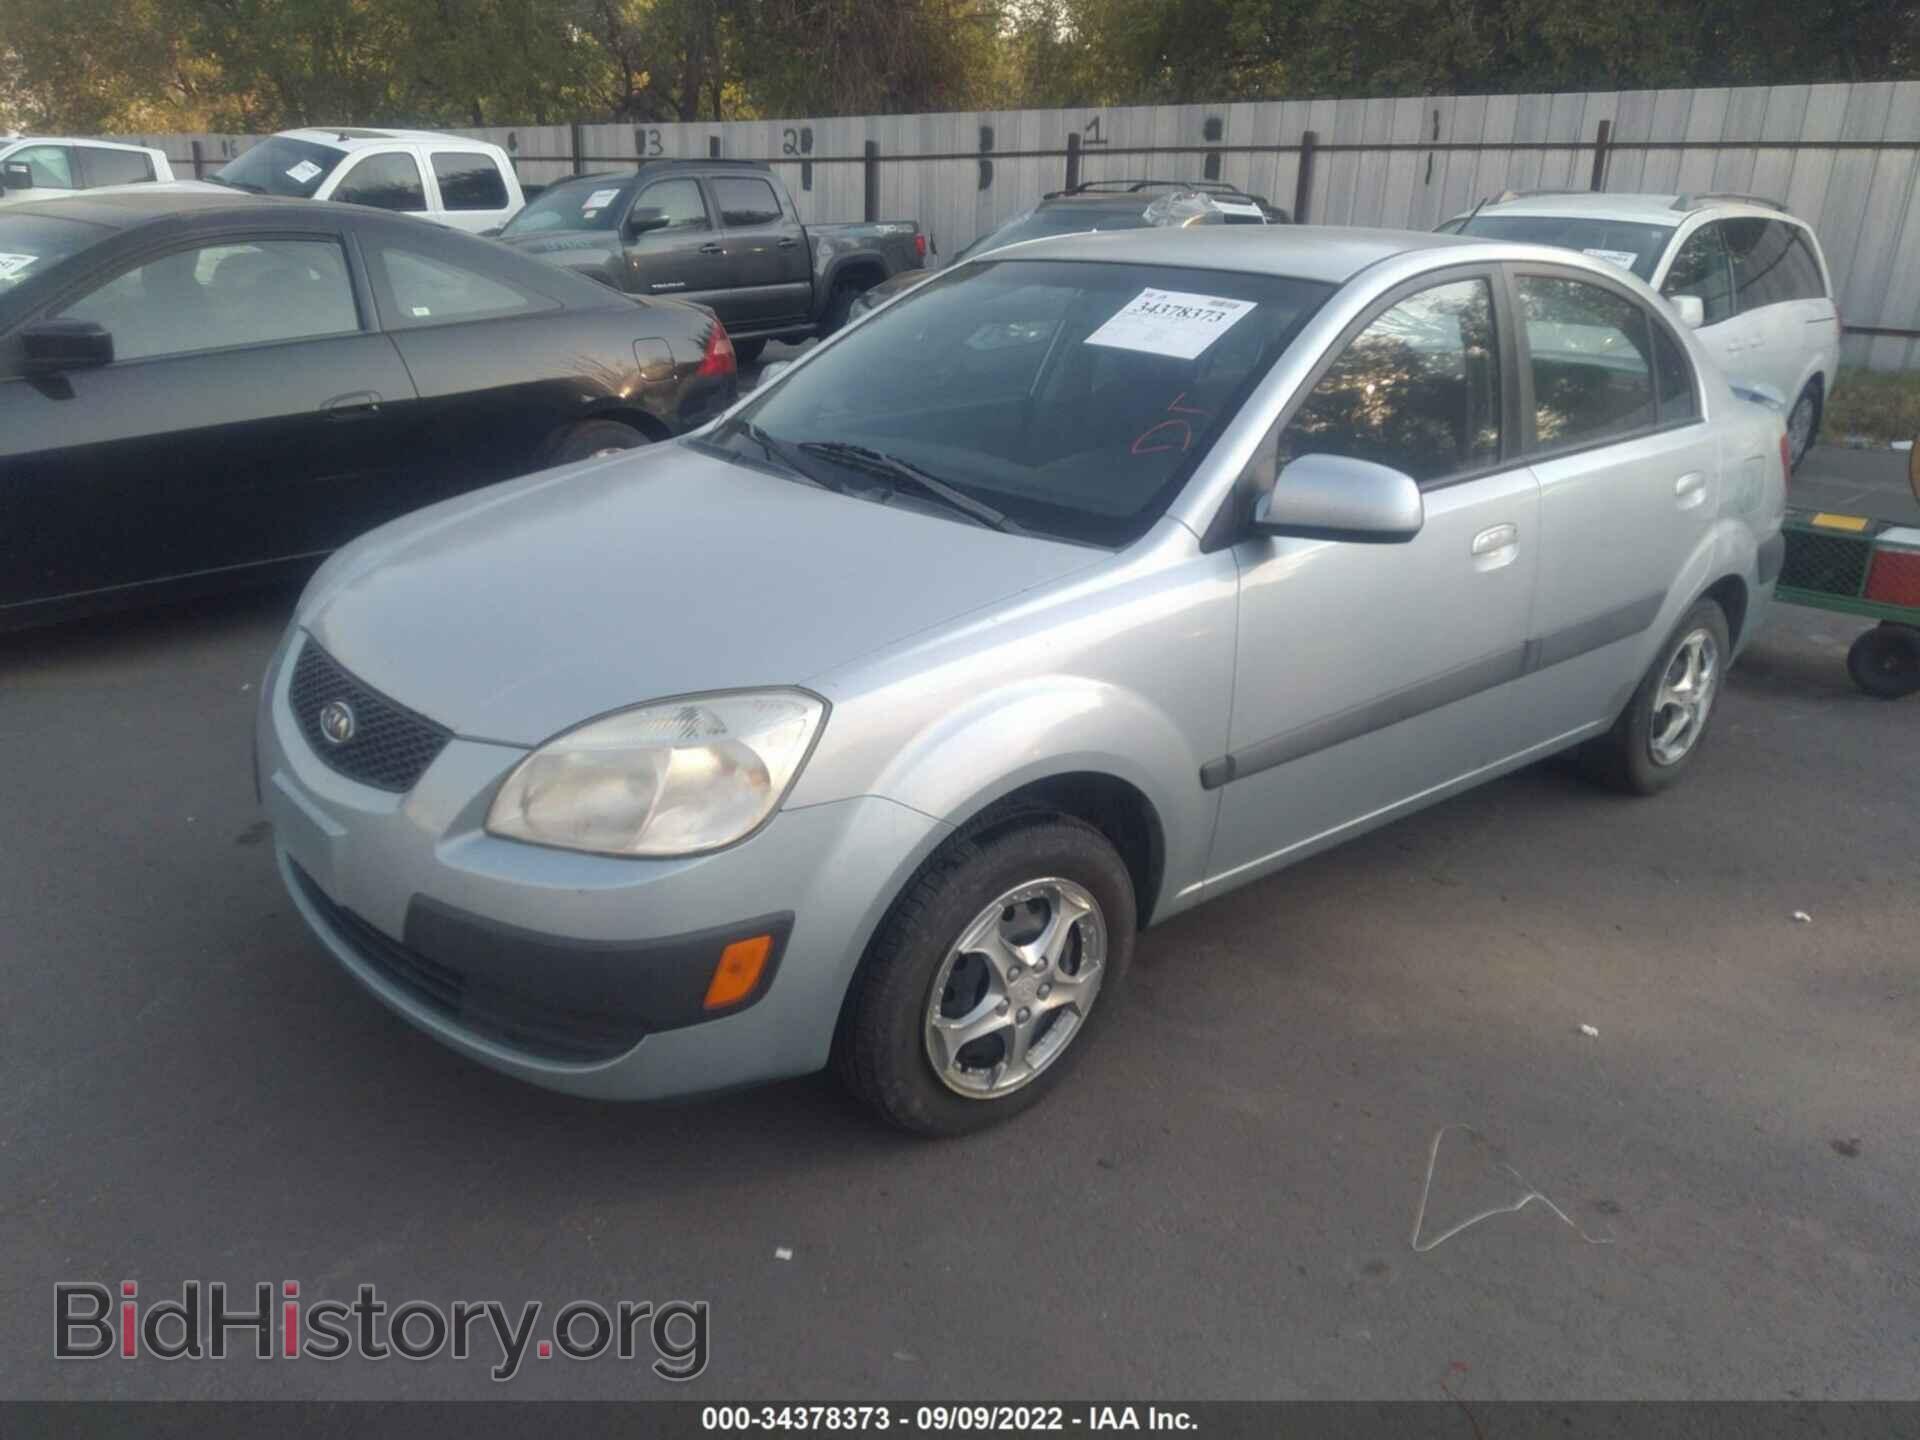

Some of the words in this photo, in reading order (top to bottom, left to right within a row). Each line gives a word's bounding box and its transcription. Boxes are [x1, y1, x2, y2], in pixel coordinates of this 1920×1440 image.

[648, 128, 664, 156] 3
[783, 128, 800, 155] 2
[1132, 302, 1226, 322] 34378373
